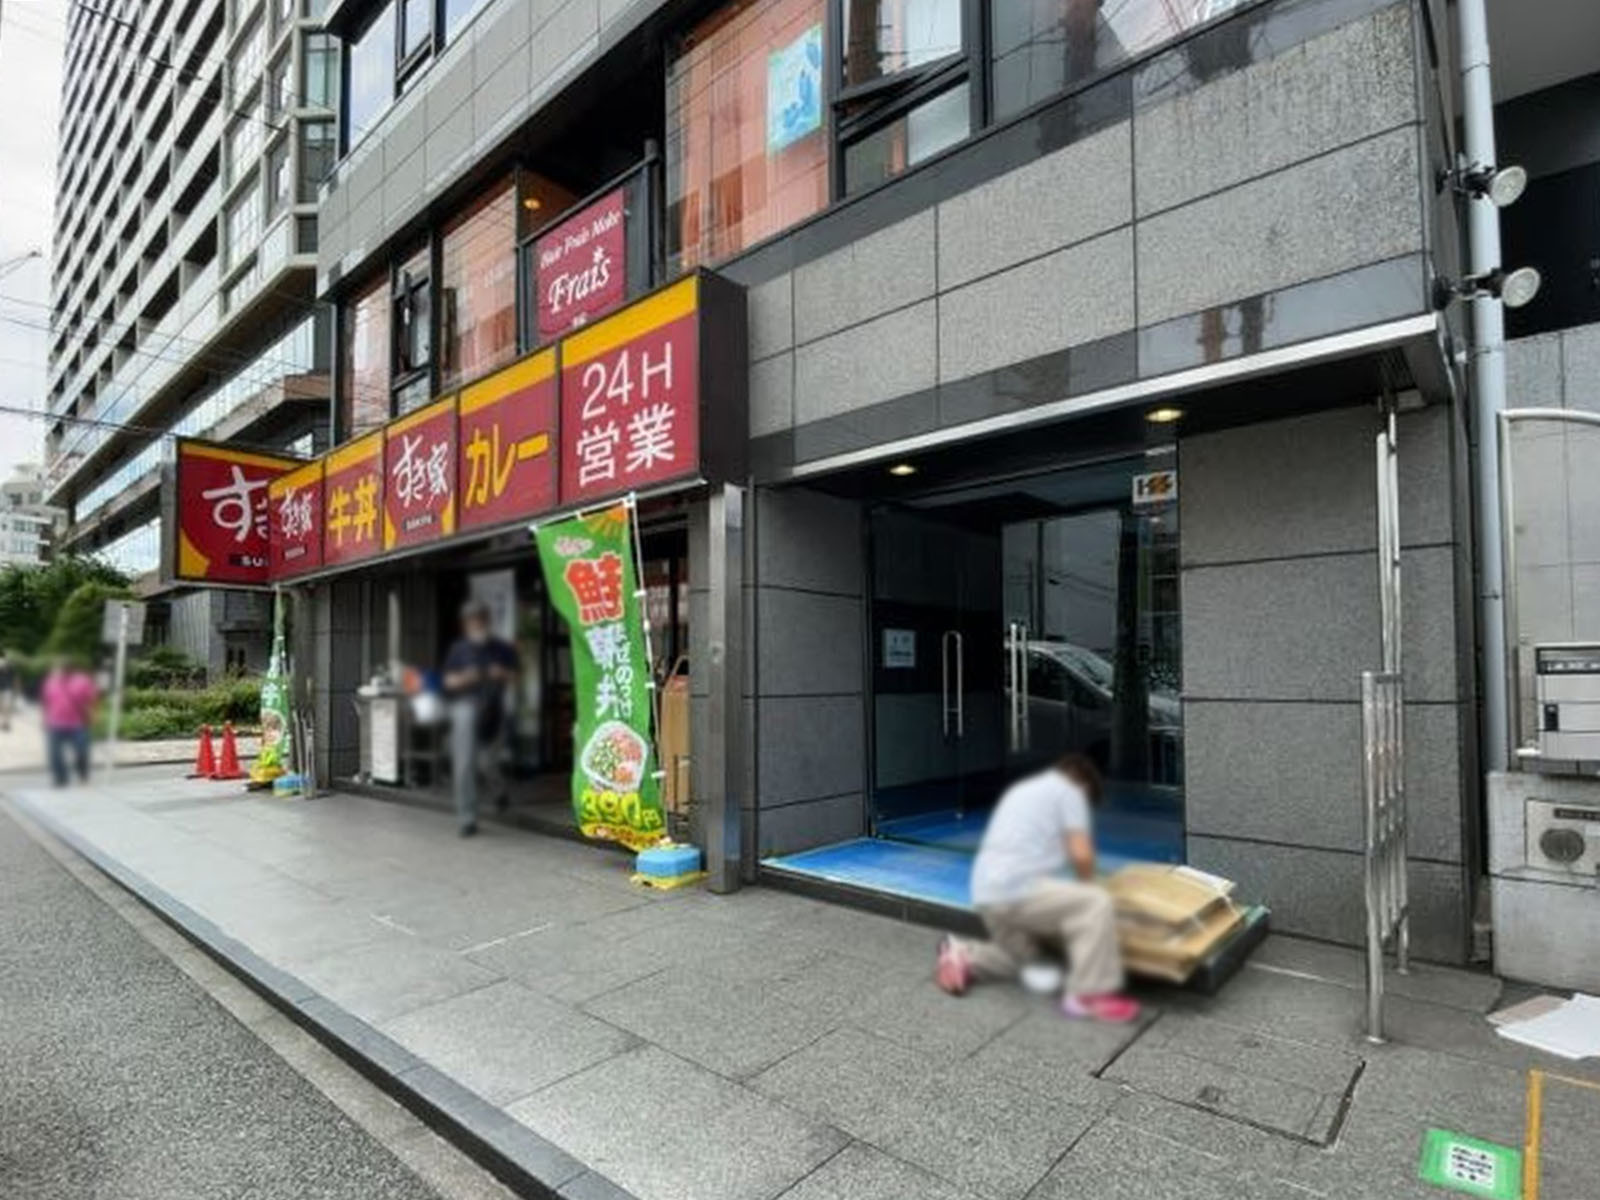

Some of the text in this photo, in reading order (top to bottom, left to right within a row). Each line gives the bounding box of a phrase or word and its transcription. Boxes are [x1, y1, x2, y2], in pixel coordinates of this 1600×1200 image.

[548, 247, 612, 314] Frais
[581, 341, 673, 420] 24H
[466, 424, 549, 509] カレー
[576, 402, 675, 487] 営業
[328, 473, 378, 547] 牛丼
